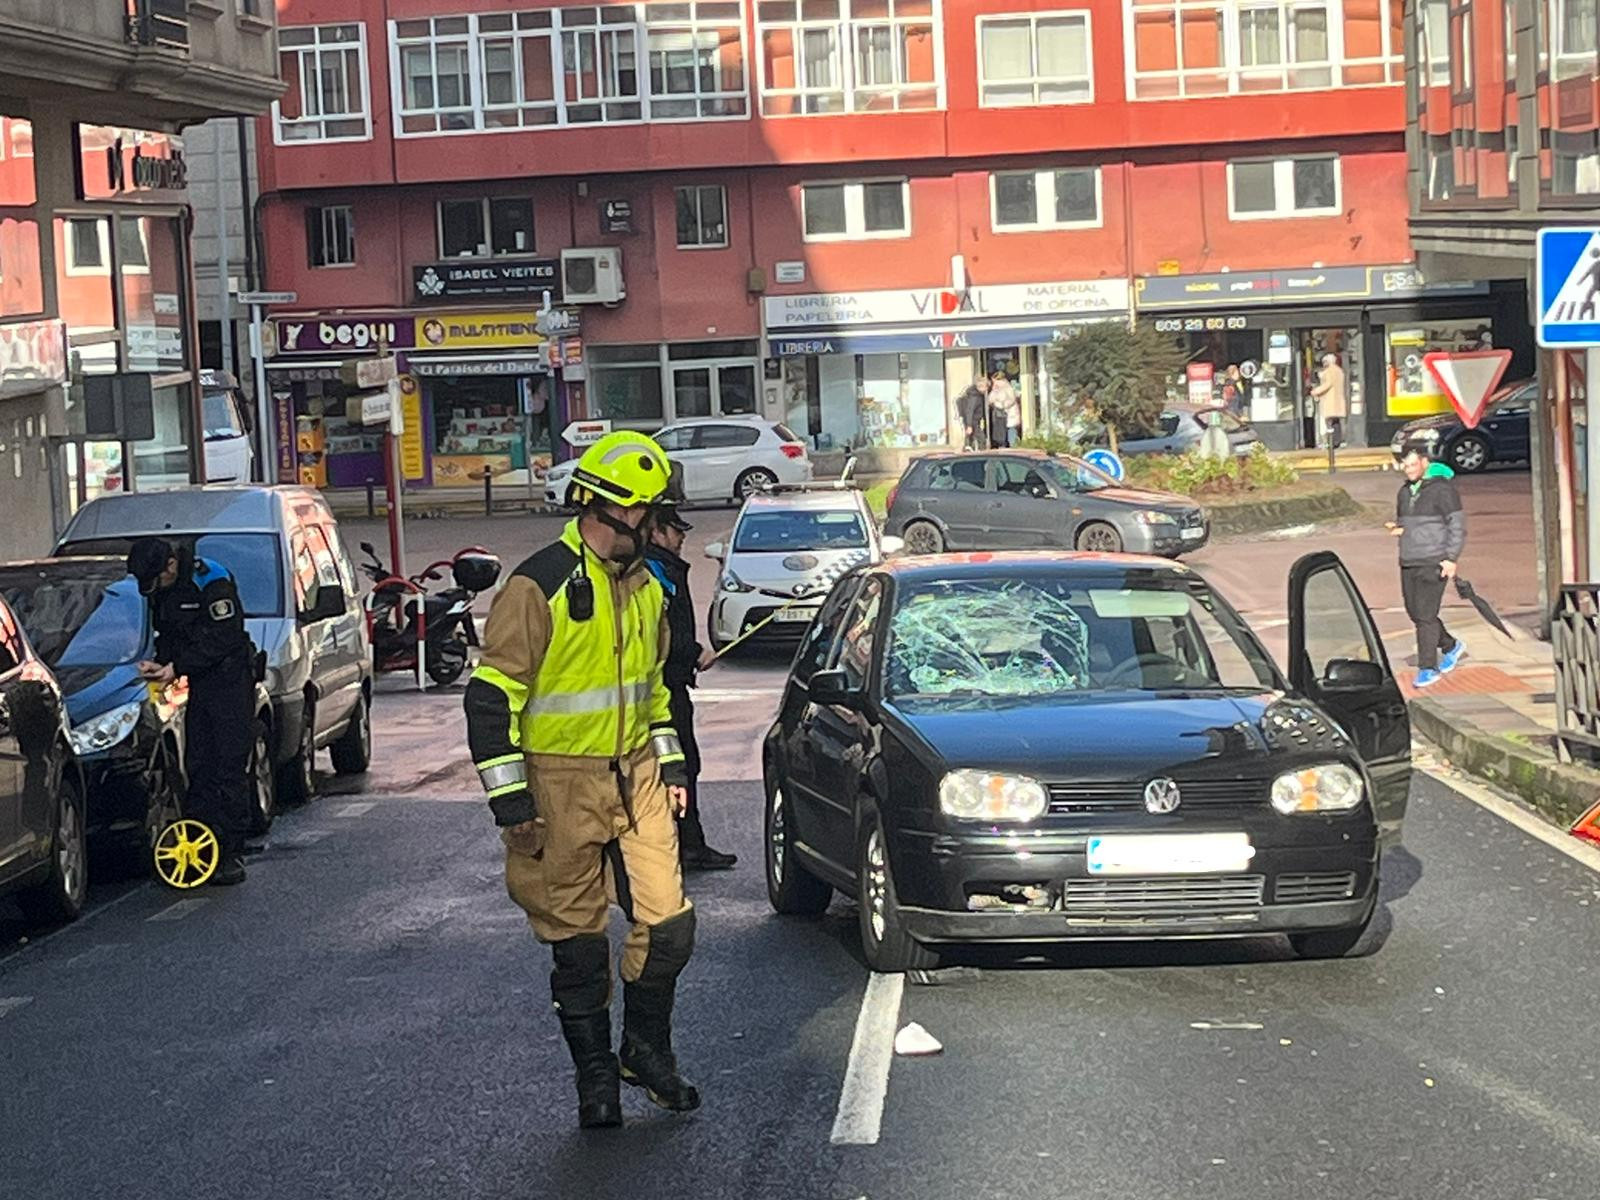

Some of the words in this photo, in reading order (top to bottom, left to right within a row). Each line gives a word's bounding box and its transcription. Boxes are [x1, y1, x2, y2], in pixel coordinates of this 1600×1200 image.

[449, 269, 497, 280] ISABEL
[502, 266, 554, 277] VIEITES
[1027, 284, 1101, 296] MATERIAL
[910, 289, 990, 315] VIDAL
[1023, 301, 1043, 311] DE
[1048, 298, 1110, 310] OFICINA
[319, 322, 396, 347] begui
[927, 331, 970, 349] VIDAL
